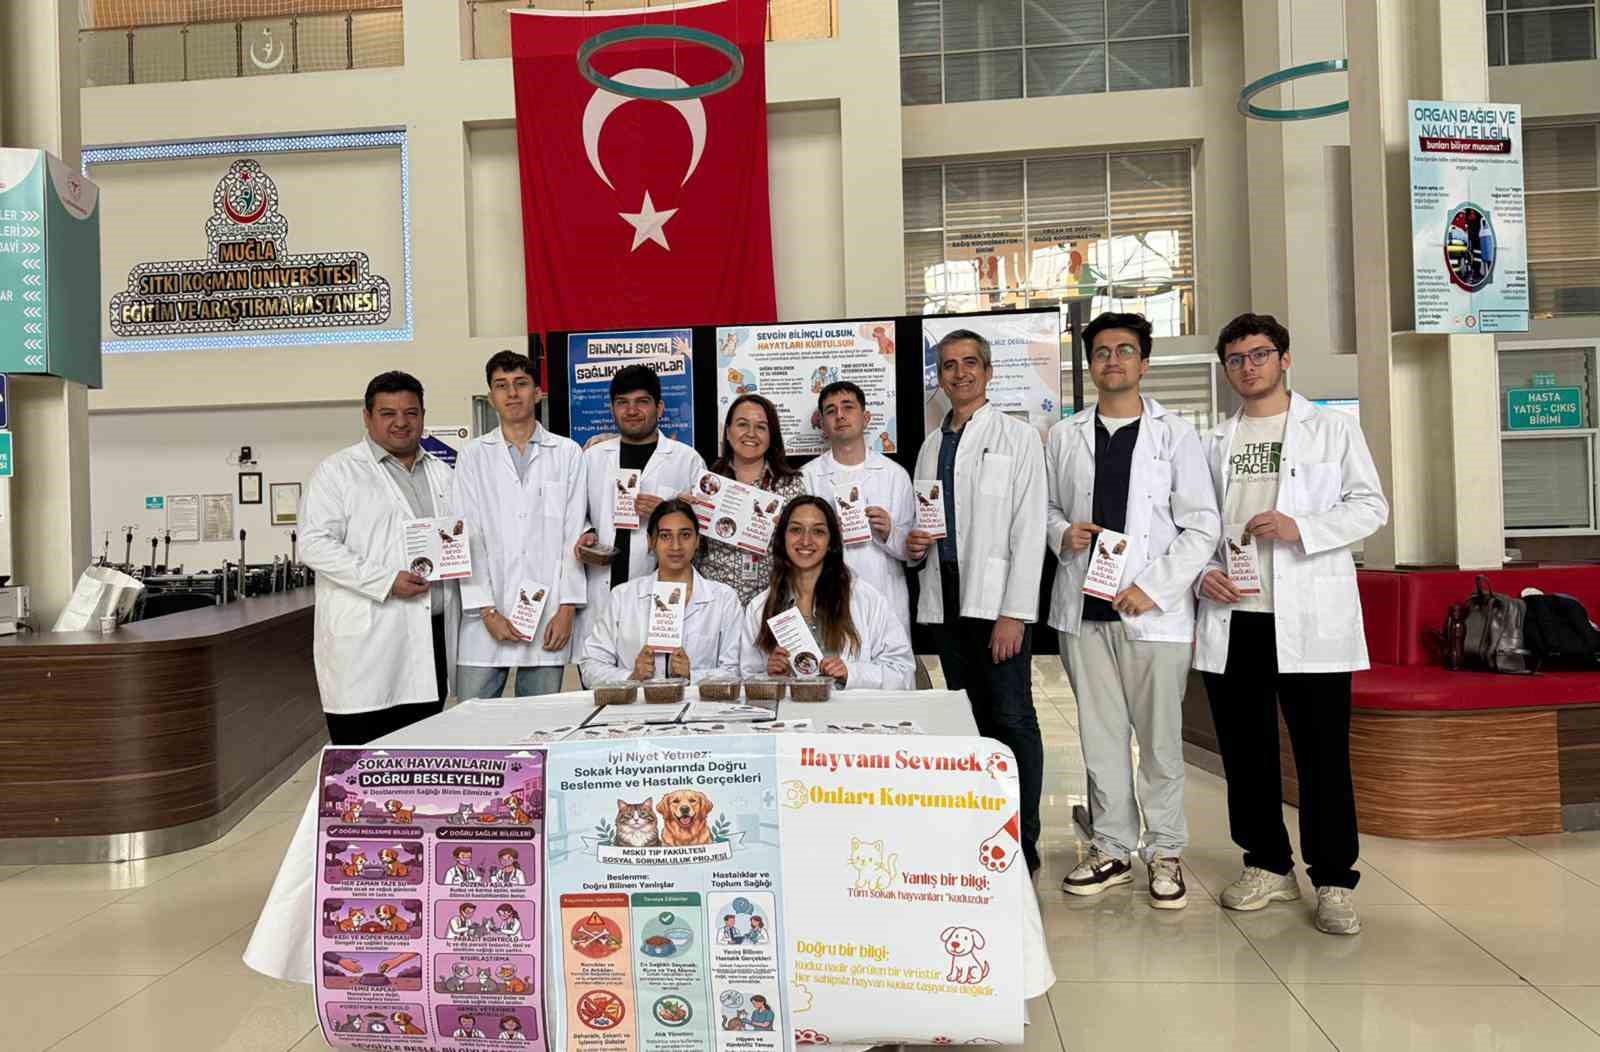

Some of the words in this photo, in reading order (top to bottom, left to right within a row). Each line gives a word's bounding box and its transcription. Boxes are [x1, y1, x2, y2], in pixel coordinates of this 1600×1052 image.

[1414, 108, 1457, 122] ORGAN
[1500, 111, 1516, 124] VE
[220, 239, 275, 262] MUĞLA
[140, 274, 178, 295] SITKI
[182, 270, 248, 296] KOÇMAN
[251, 260, 358, 289] ÜNİVERSİTESİ
[121, 300, 176, 324] EĞİTİM
[178, 301, 198, 320] VE
[200, 297, 288, 325] ARAŞTIRMA
[292, 287, 379, 315] HASTANESİ
[788, 329, 823, 341] BİLİNÇLİ
[1528, 392, 1560, 402] HASTA
[1529, 413, 1561, 425] BİRİMİ
[1245, 442, 1270, 453] THE
[1229, 452, 1269, 465] ORTH
[1235, 463, 1268, 475] FACE
[608, 752, 622, 764] İyi
[625, 751, 658, 763] Niyet
[660, 750, 712, 761] Yetmez:
[895, 750, 982, 772] Sevmek
[358, 758, 404, 770] SOKAK
[406, 758, 507, 771] HAYVANLARINI
[574, 766, 612, 777] Sokak
[615, 763, 705, 777] Hayvanlarında
[708, 761, 747, 774] Doğru
[362, 771, 410, 785] DOĞRU
[413, 773, 501, 787] BESLEYELİM!
[560, 779, 622, 791] Beslenme
[625, 780, 640, 788] ve
[643, 775, 693, 787] Hastalık
[694, 772, 761, 787] Gerçekleri
[442, 788, 458, 796] Bizim
[461, 789, 492, 797] Elimizde
[809, 785, 875, 805] Onları
[623, 848, 646, 856] MSKÜ
[663, 847, 706, 855] FAKÜLTESİ
[635, 857, 691, 865] SORUMLULUK
[693, 853, 727, 863] PROJESİ
[607, 873, 650, 881] Beslenme:
[712, 879, 742, 888] Toplum
[743, 878, 772, 888] Sağlığı
[713, 872, 758, 880] Hastalıklar
[902, 871, 938, 888] Yanlış
[940, 872, 958, 886] bir
[583, 881, 608, 890] Doğru
[609, 881, 637, 889] Bilinen
[639, 880, 675, 890] Yanlışlar
[848, 888, 868, 898] Tüm
[870, 889, 896, 899] sokak
[898, 891, 944, 902] hayvanları
[797, 941, 836, 957] Doğru
[839, 943, 857, 957] bir
[825, 961, 848, 972] nadir
[882, 964, 900, 977] bir
[850, 976, 886, 989] hayvan
[887, 979, 914, 990] kuduz
